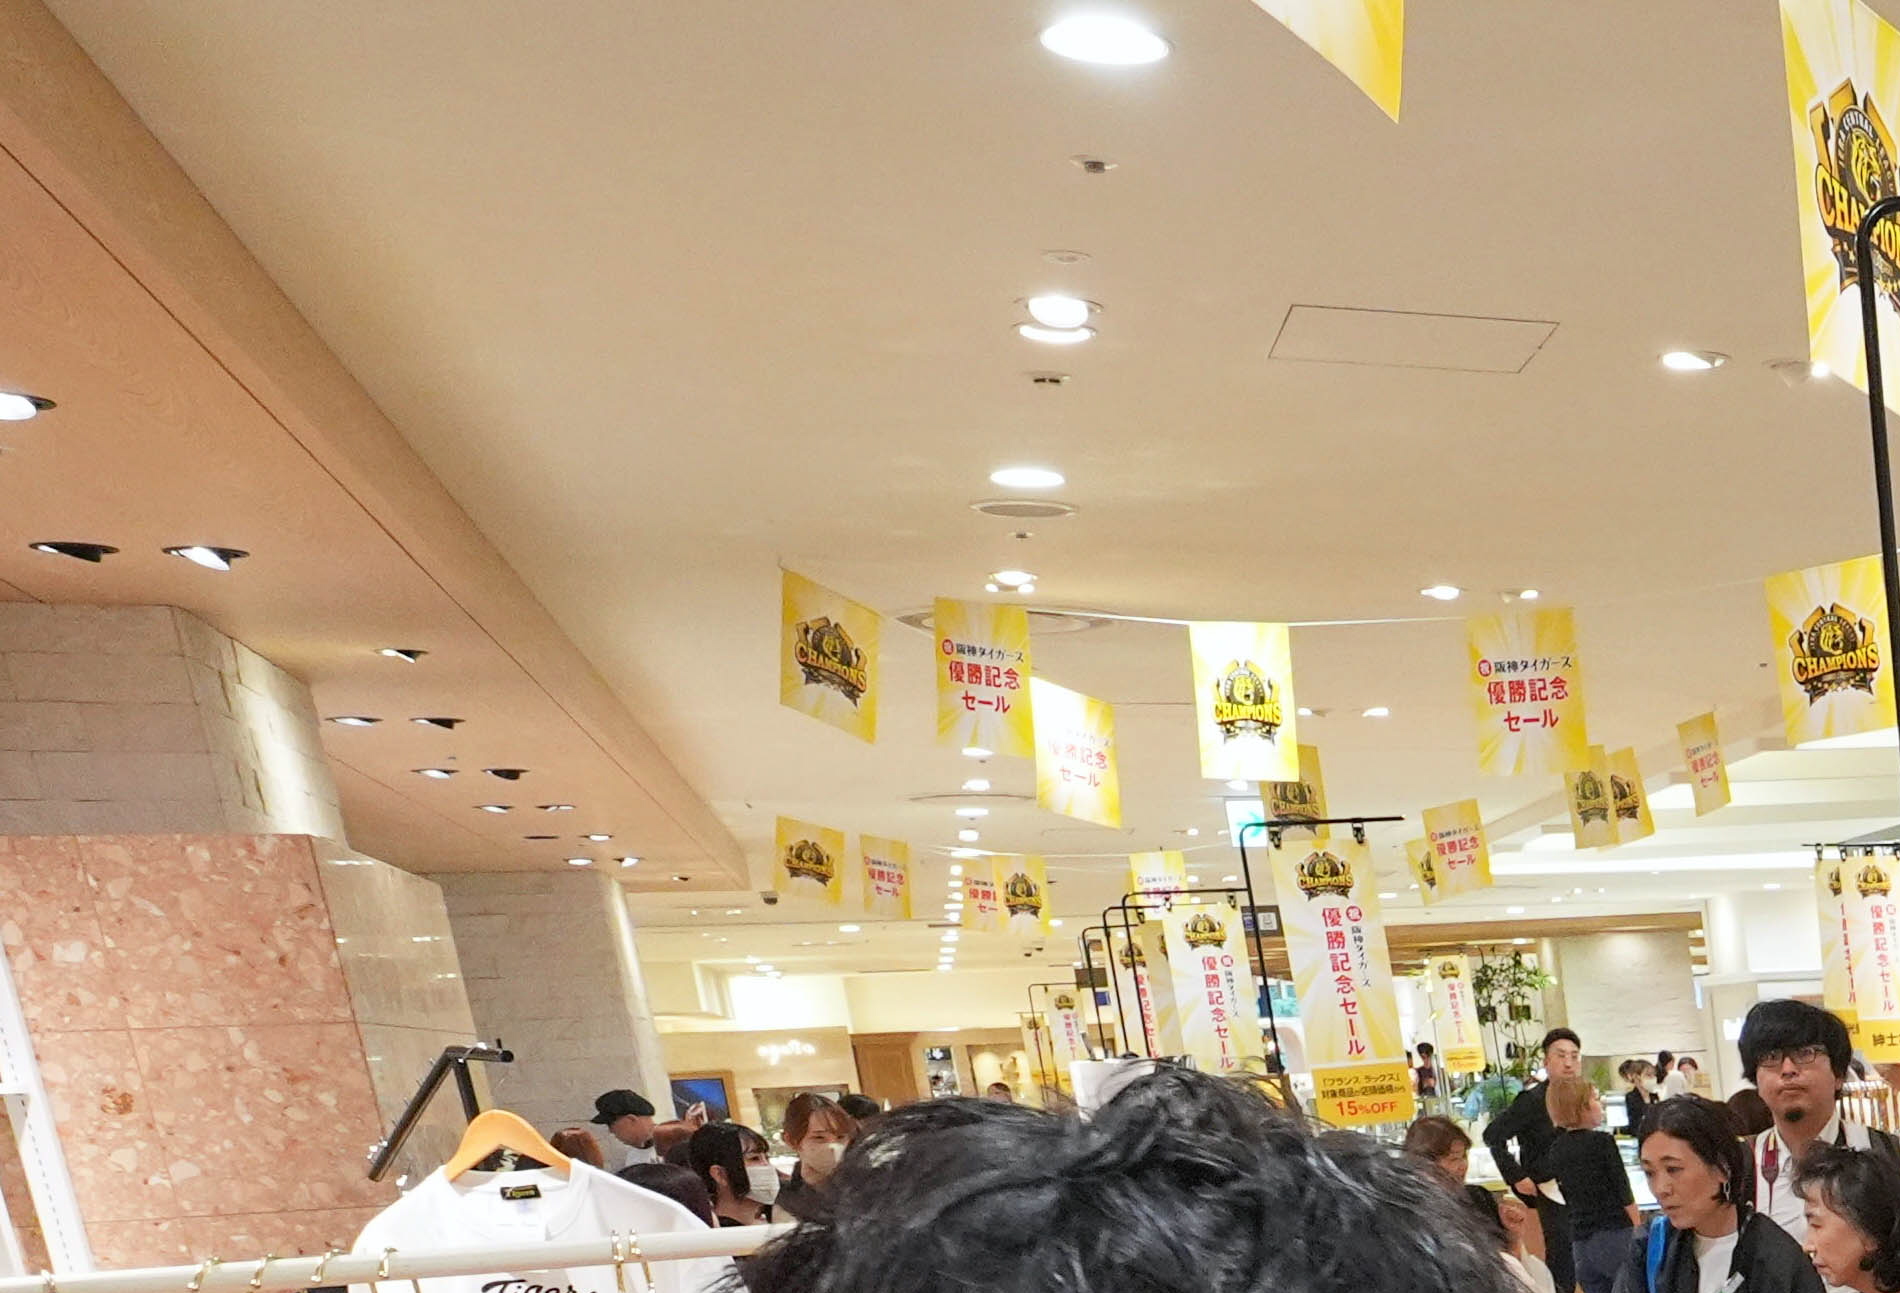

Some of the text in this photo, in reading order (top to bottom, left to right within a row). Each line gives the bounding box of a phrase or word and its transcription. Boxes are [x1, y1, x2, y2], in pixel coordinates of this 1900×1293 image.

[794, 640, 868, 693] CHAMPIONS
[949, 660, 1021, 691] 優勝記念
[1792, 643, 1880, 685] CHAMPIONS
[961, 690, 1011, 714] セール
[1487, 676, 1569, 705] 優勝記念
[1213, 701, 1283, 728] CHAMPIONS
[1503, 709, 1559, 734] セール
[1060, 766, 1101, 788] セール
[1447, 854, 1477, 869] セール
[1321, 906, 1366, 1056] 優勝記念セール
[1201, 955, 1235, 1070] 優勝記念セール
[1335, 1099, 1400, 1117] 15%OFF
